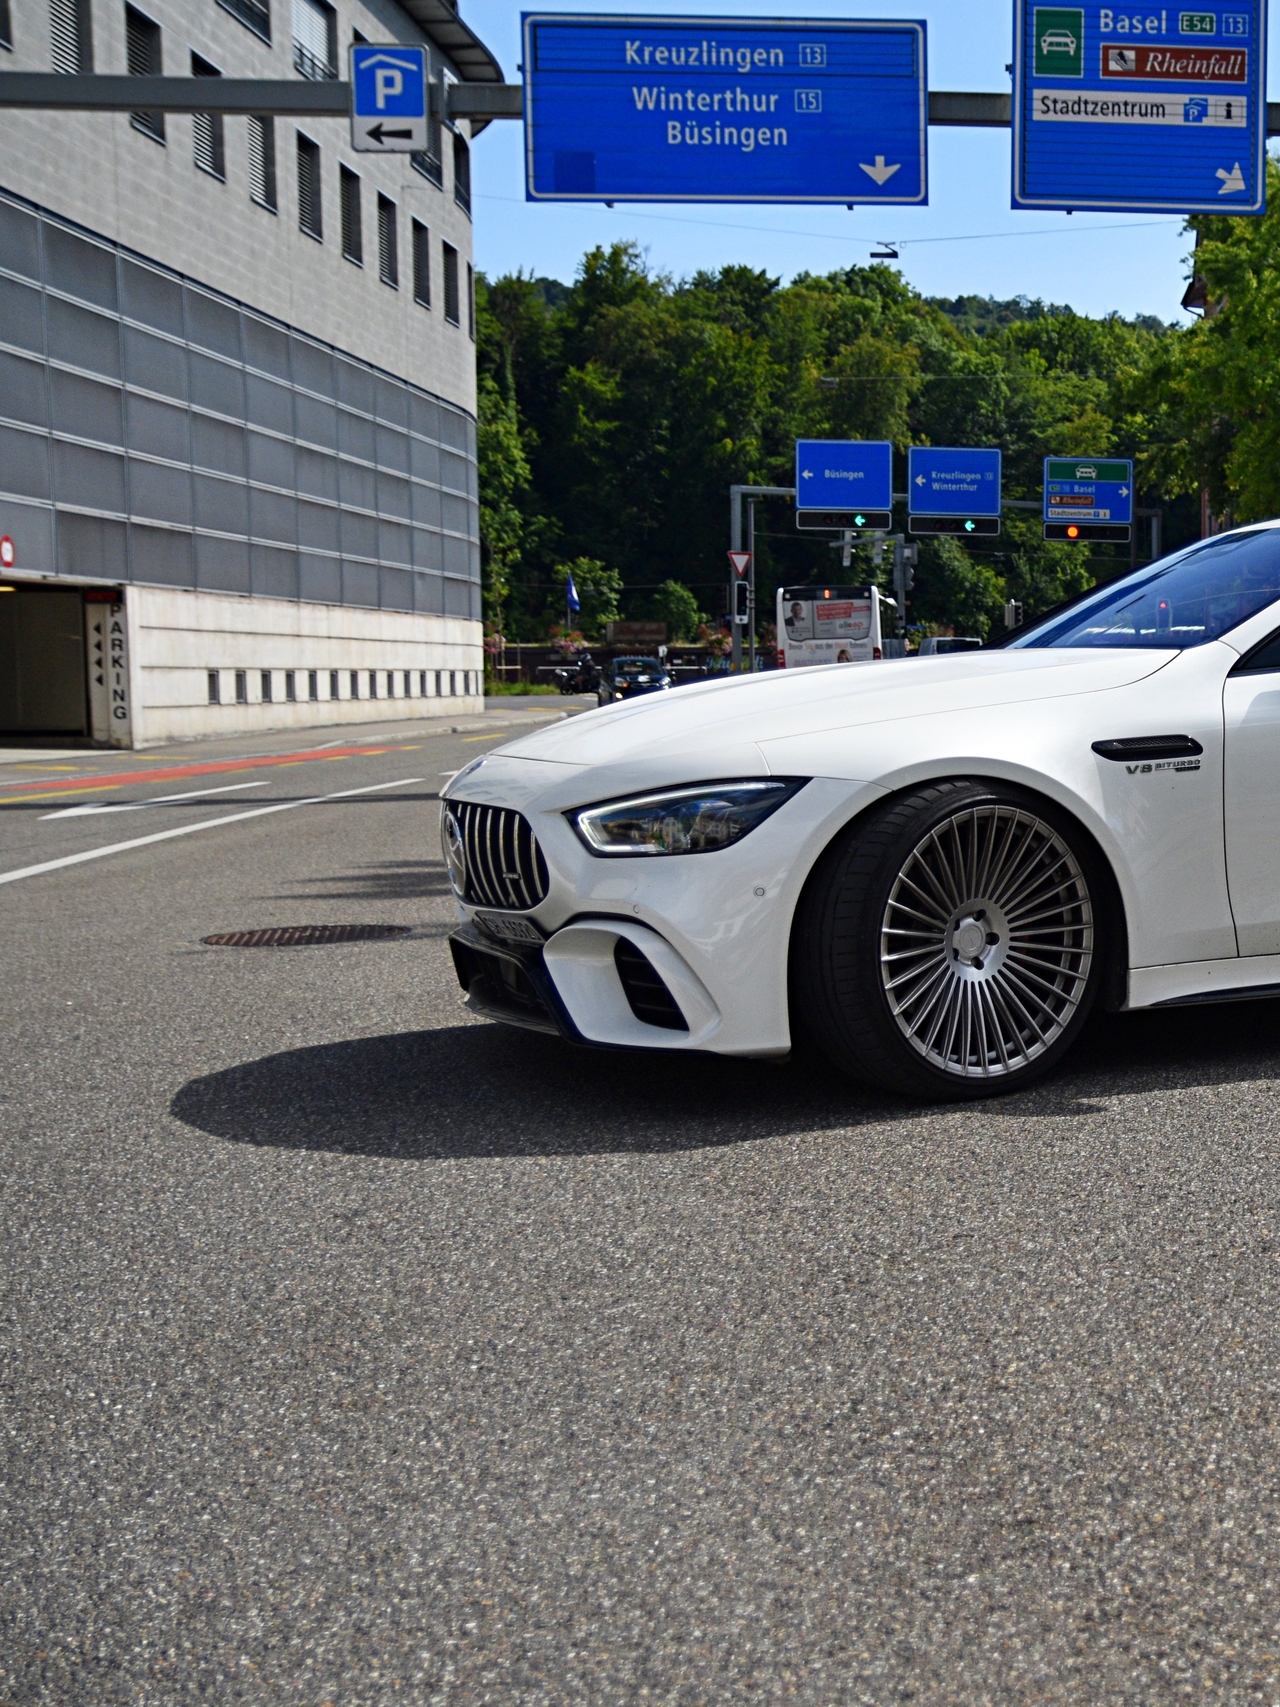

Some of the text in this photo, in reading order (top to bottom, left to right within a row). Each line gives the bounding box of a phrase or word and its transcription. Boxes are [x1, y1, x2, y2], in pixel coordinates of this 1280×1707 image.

[1099, 9, 1167, 34] Basel
[1227, 17, 1243, 33] 13
[625, 41, 823, 73] Kreuzlingen 13
[1145, 51, 1243, 80] Rheinfall
[375, 69, 402, 109] P
[632, 86, 817, 112] Winterthur 15
[1040, 95, 1166, 118] Stadtzentrum
[667, 121, 788, 151] Büsingen
[824, 469, 864, 481] Büsingen
[931, 470, 982, 481] Kreuzlingen
[931, 482, 978, 491] Winterthur
[1074, 484, 1096, 493] Basel
[1050, 509, 1093, 517] Stadtzentrum
[109, 604, 127, 720] PARKING
[1126, 763, 1153, 774] V8
[1155, 759, 1201, 769] BITURBO
